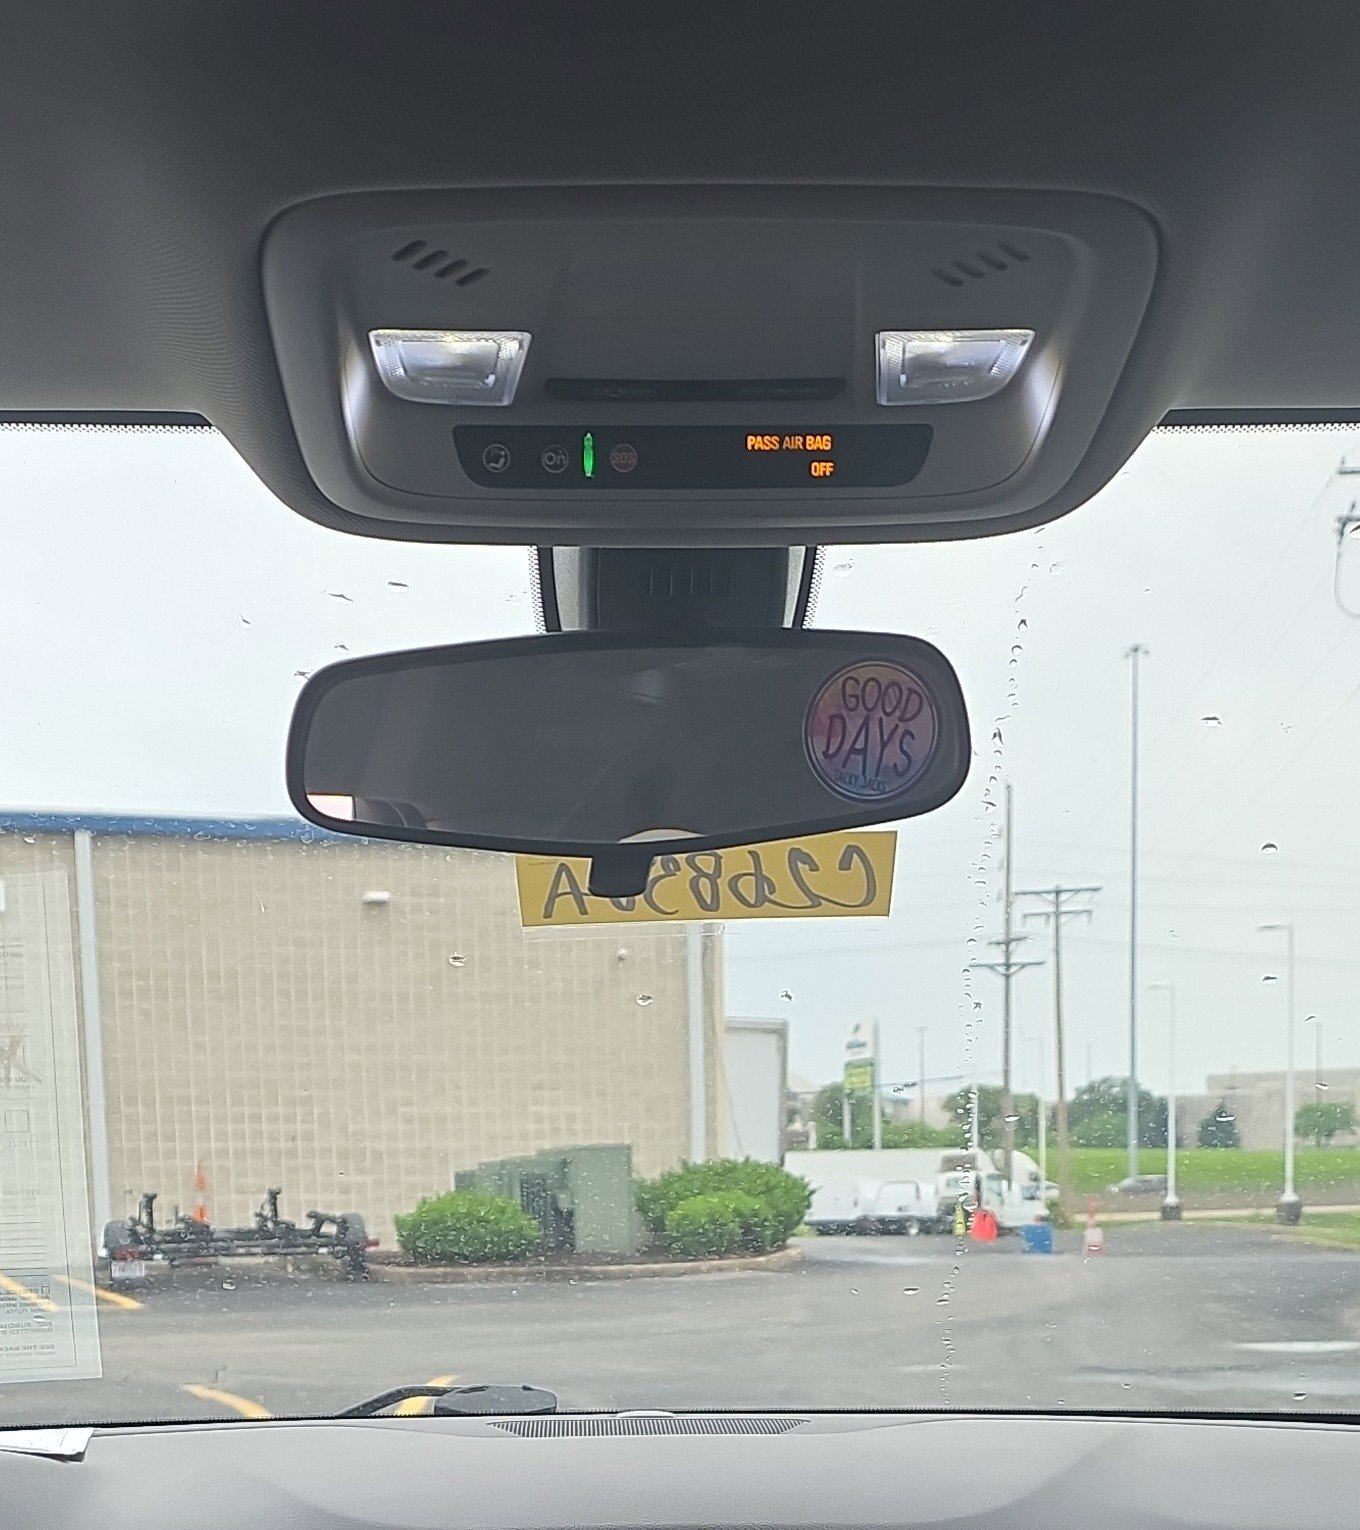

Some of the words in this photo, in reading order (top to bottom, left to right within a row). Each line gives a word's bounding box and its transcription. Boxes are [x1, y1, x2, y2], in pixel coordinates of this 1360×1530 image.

[746, 435, 780, 451] PASS
[782, 435, 804, 450] AIR
[805, 435, 832, 450] BAG
[611, 452, 637, 464] SOS
[810, 461, 834, 476] OFF
[840, 675, 923, 723] GOOD
[821, 713, 916, 779] DAYS
